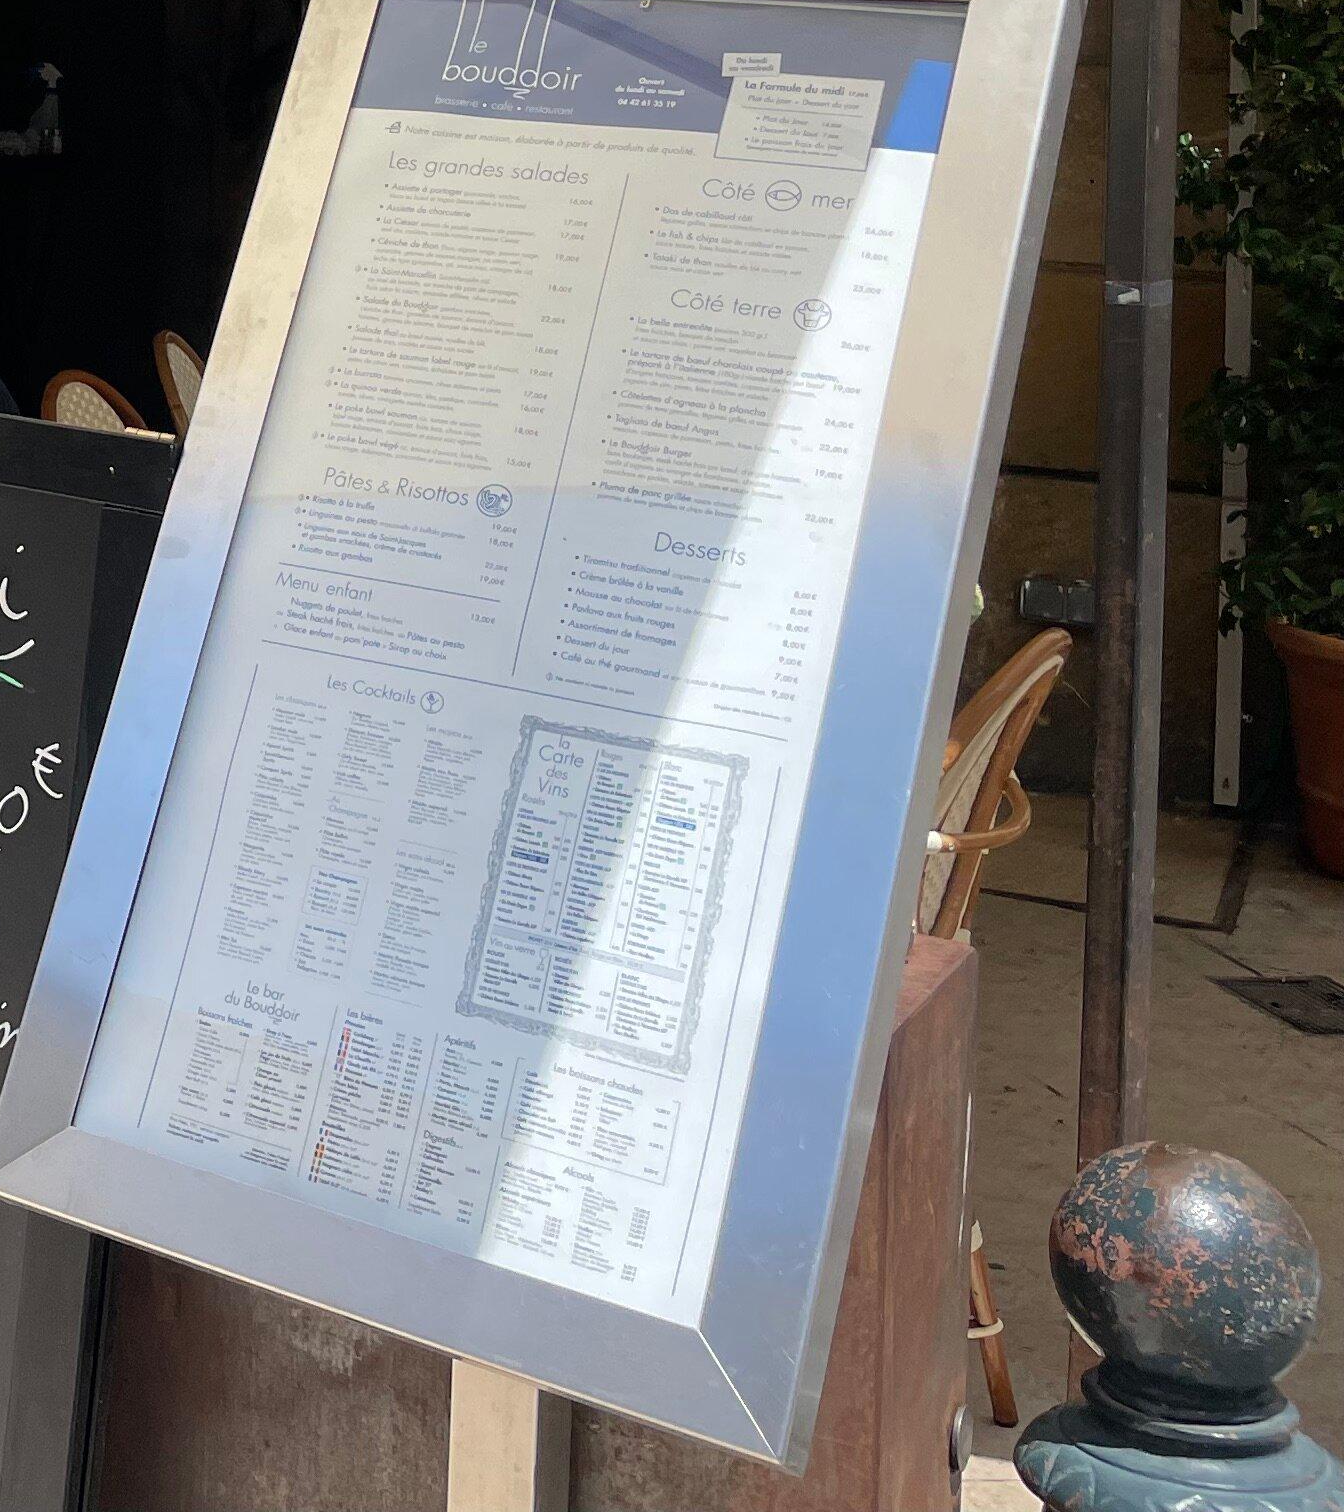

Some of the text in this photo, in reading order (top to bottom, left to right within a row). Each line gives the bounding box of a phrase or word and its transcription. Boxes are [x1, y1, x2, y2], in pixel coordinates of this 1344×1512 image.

[744, 80, 845, 96] La Formule du midi
[404, 124, 430, 136] Notre
[566, 138, 591, 152] partir
[593, 140, 604, 149] de
[647, 144, 659, 153] de
[388, 150, 589, 185] Les grandes salades
[702, 178, 856, 210] Côté mer
[663, 206, 735, 220] Dos de cabillaud
[669, 230, 683, 239] fish
[696, 234, 719, 244] chips
[680, 254, 690, 263] de
[670, 288, 781, 319] Côté terre
[692, 424, 719, 436] Angus
[663, 447, 692, 458] Burger
[323, 467, 470, 506] Pâtes & Risottos
[654, 531, 746, 567] Desserts
[275, 571, 373, 602] Menu enfant
[579, 570, 606, 582] Crème
[645, 581, 653, 590] la
[656, 585, 684, 596] vanille
[576, 588, 662, 609] Mousse au chocolat
[568, 619, 677, 647] Assortiment de fromages
[647, 615, 675, 629] rouges
[565, 635, 595, 647] Dessert
[598, 641, 609, 650] du
[425, 649, 447, 661] choix
[561, 651, 581, 662] Café
[599, 658, 612, 668] thé
[615, 662, 660, 678] gourmand
[327, 674, 416, 705] Les Cocktails
[559, 734, 570, 748] la
[539, 745, 584, 768] Carte
[546, 764, 568, 780] des
[539, 777, 569, 799] Vins
[246, 979, 285, 1001] Le bar
[224, 991, 300, 1022] du Bouddoir
[346, 1008, 358, 1018] Les
